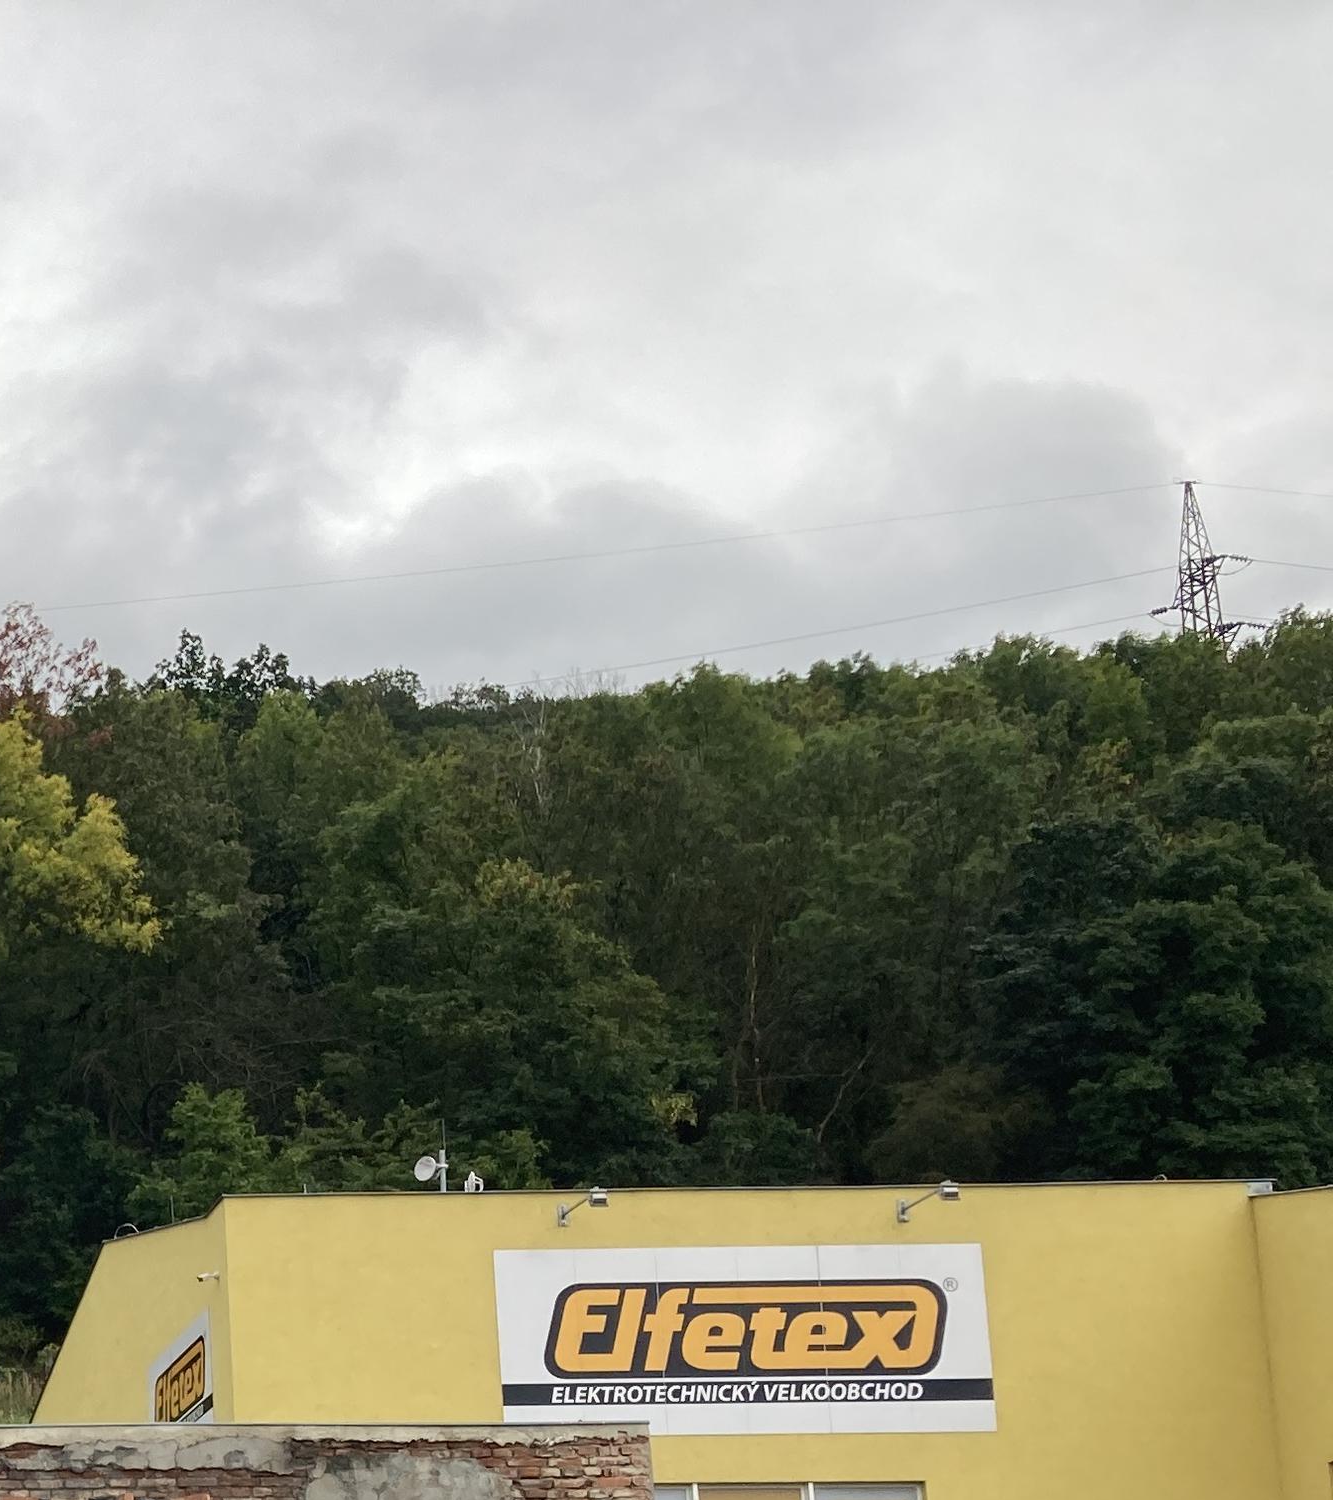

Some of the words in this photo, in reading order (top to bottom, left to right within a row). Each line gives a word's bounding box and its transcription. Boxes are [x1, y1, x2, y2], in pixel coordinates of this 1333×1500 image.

[554, 1284, 939, 1373] Elfetex
[550, 1381, 760, 1404] ELEKTROTECHNICKÝ
[763, 1382, 925, 1402] VELKOOBCHOD
